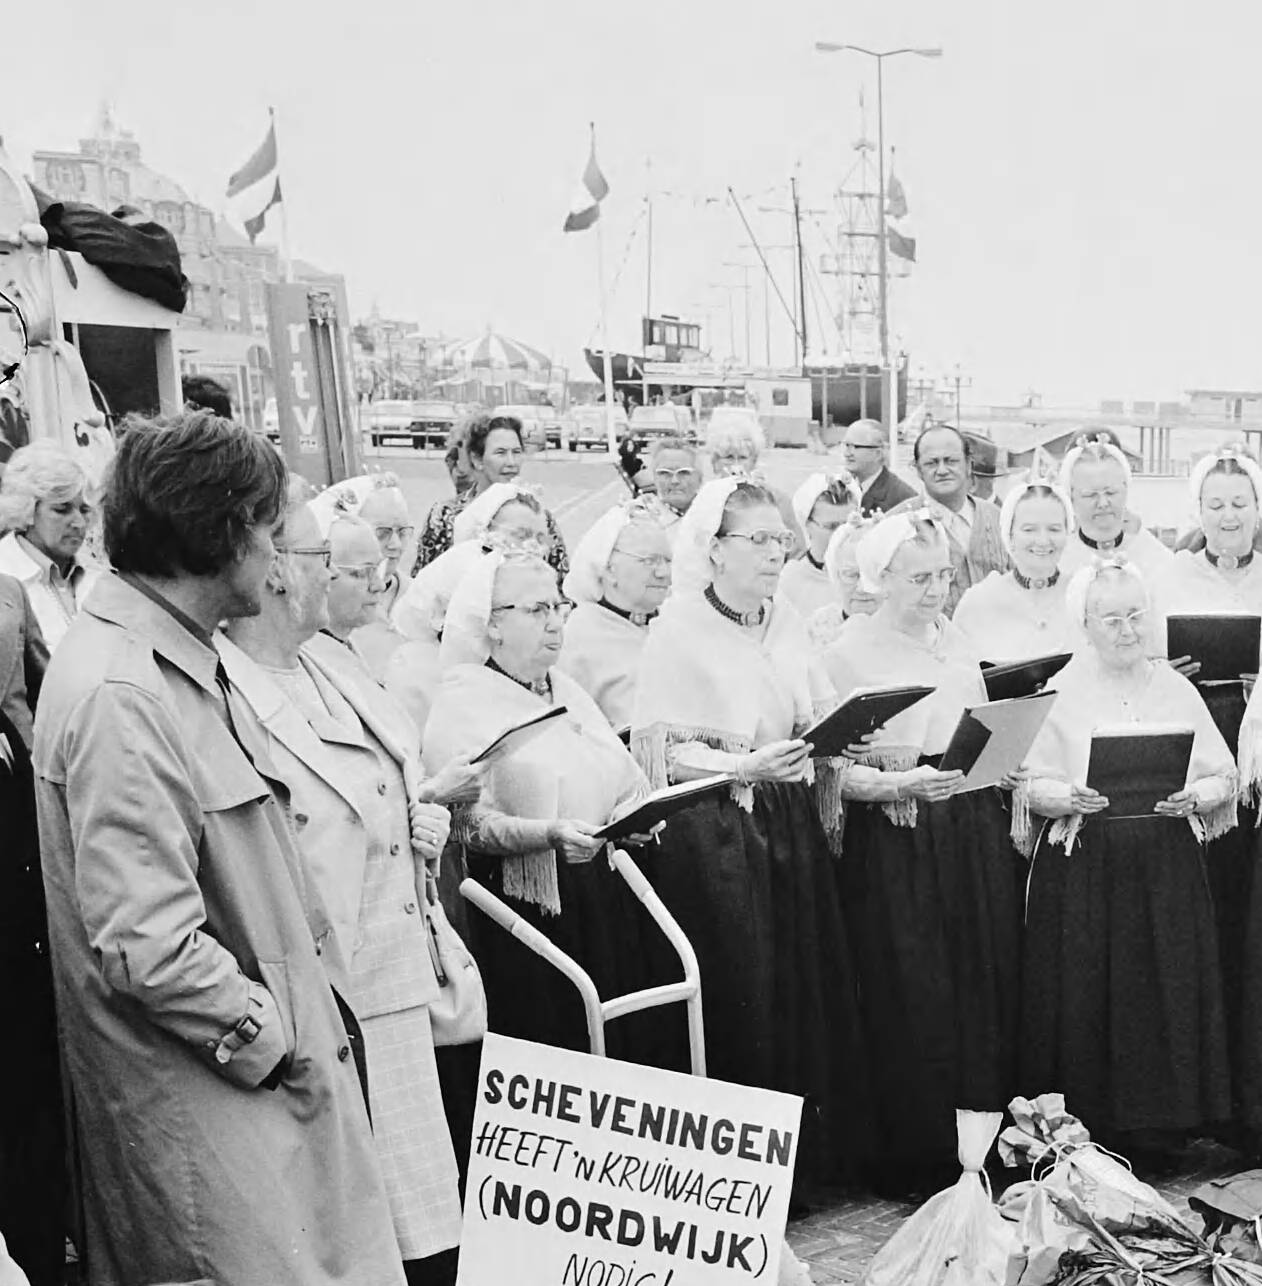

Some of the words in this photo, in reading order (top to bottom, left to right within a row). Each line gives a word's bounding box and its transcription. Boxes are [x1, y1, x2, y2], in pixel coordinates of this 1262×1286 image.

[286, 322, 319, 435] rtv
[476, 1122, 573, 1172] HEEFT
[483, 1068, 793, 1167] SCHEVENINGEN
[478, 1175, 769, 1280] (NOORDWIJK)
